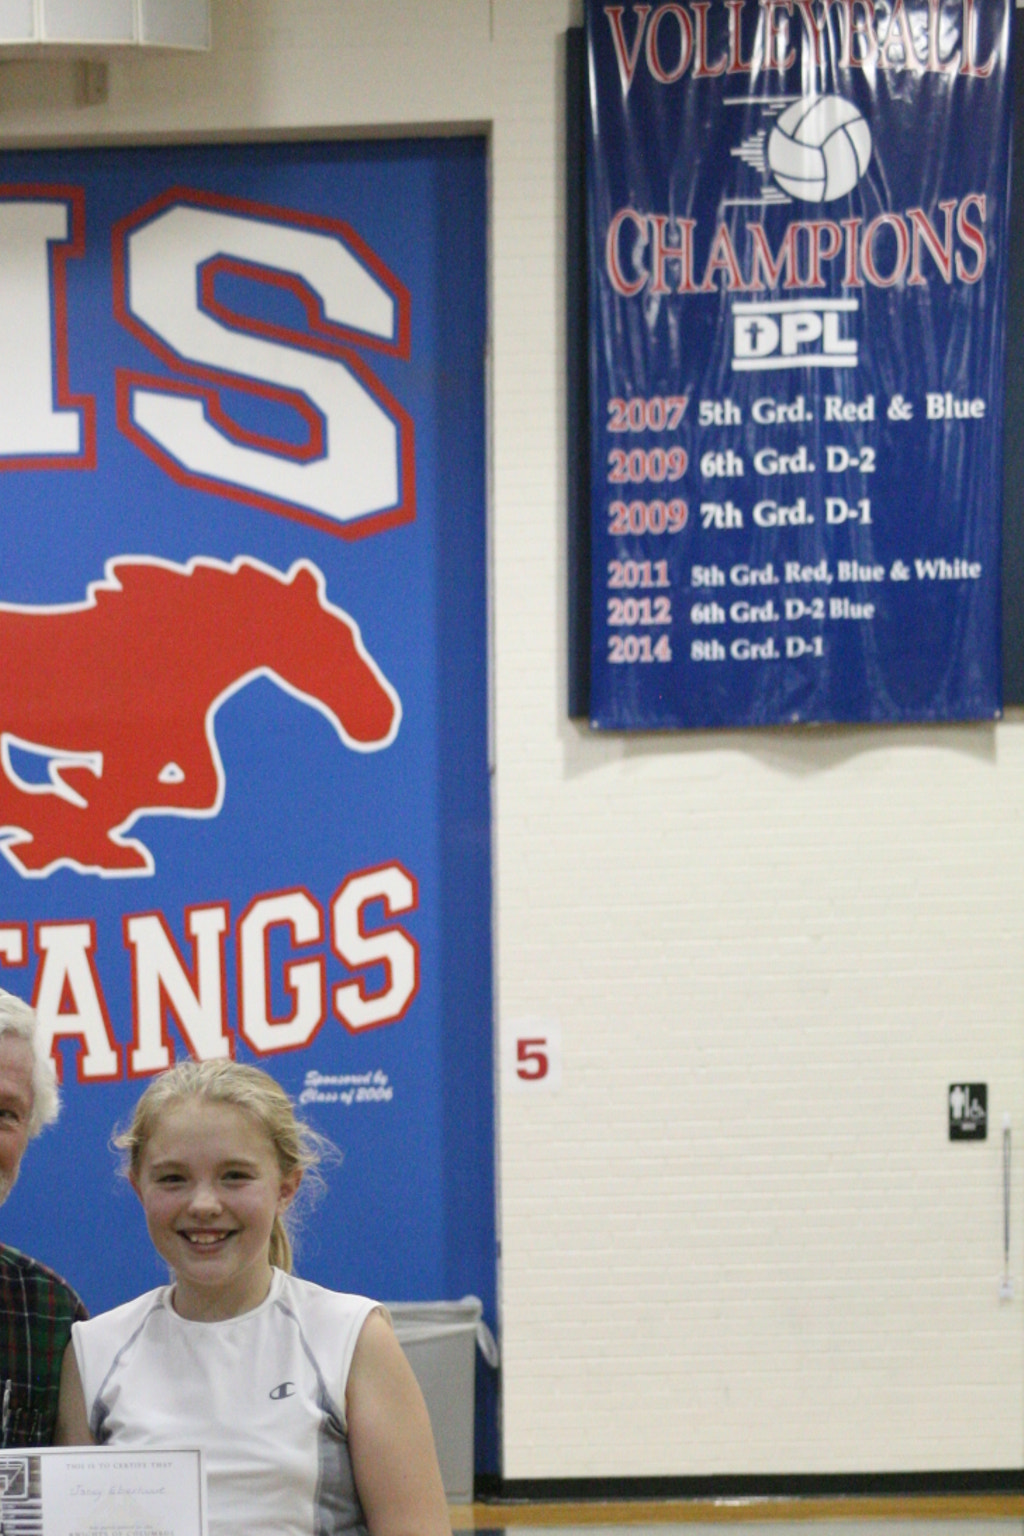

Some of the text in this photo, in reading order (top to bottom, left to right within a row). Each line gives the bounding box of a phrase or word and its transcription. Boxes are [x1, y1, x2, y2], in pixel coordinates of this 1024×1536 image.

[605, 0, 996, 85] VOLLEYBALL
[606, 193, 987, 297] CHAMPIONS
[733, 310, 859, 358] DPL
[607, 392, 986, 432] 2007 5th Grd. Red & Blue
[607, 446, 877, 483] 2009 6th Grd. D-2
[607, 498, 873, 535] 2009 7th Grd. D-1
[607, 560, 671, 589] 2011
[691, 565, 726, 587] 5th
[730, 563, 780, 586] Grd.
[837, 560, 885, 582] Blue
[890, 560, 911, 582] &
[914, 558, 982, 581] White
[607, 597, 876, 626] 2012 6th Grd. D-2 Blue
[607, 635, 825, 663] 2014 8th Grd. D-1
[516, 1037, 548, 1081] 5
